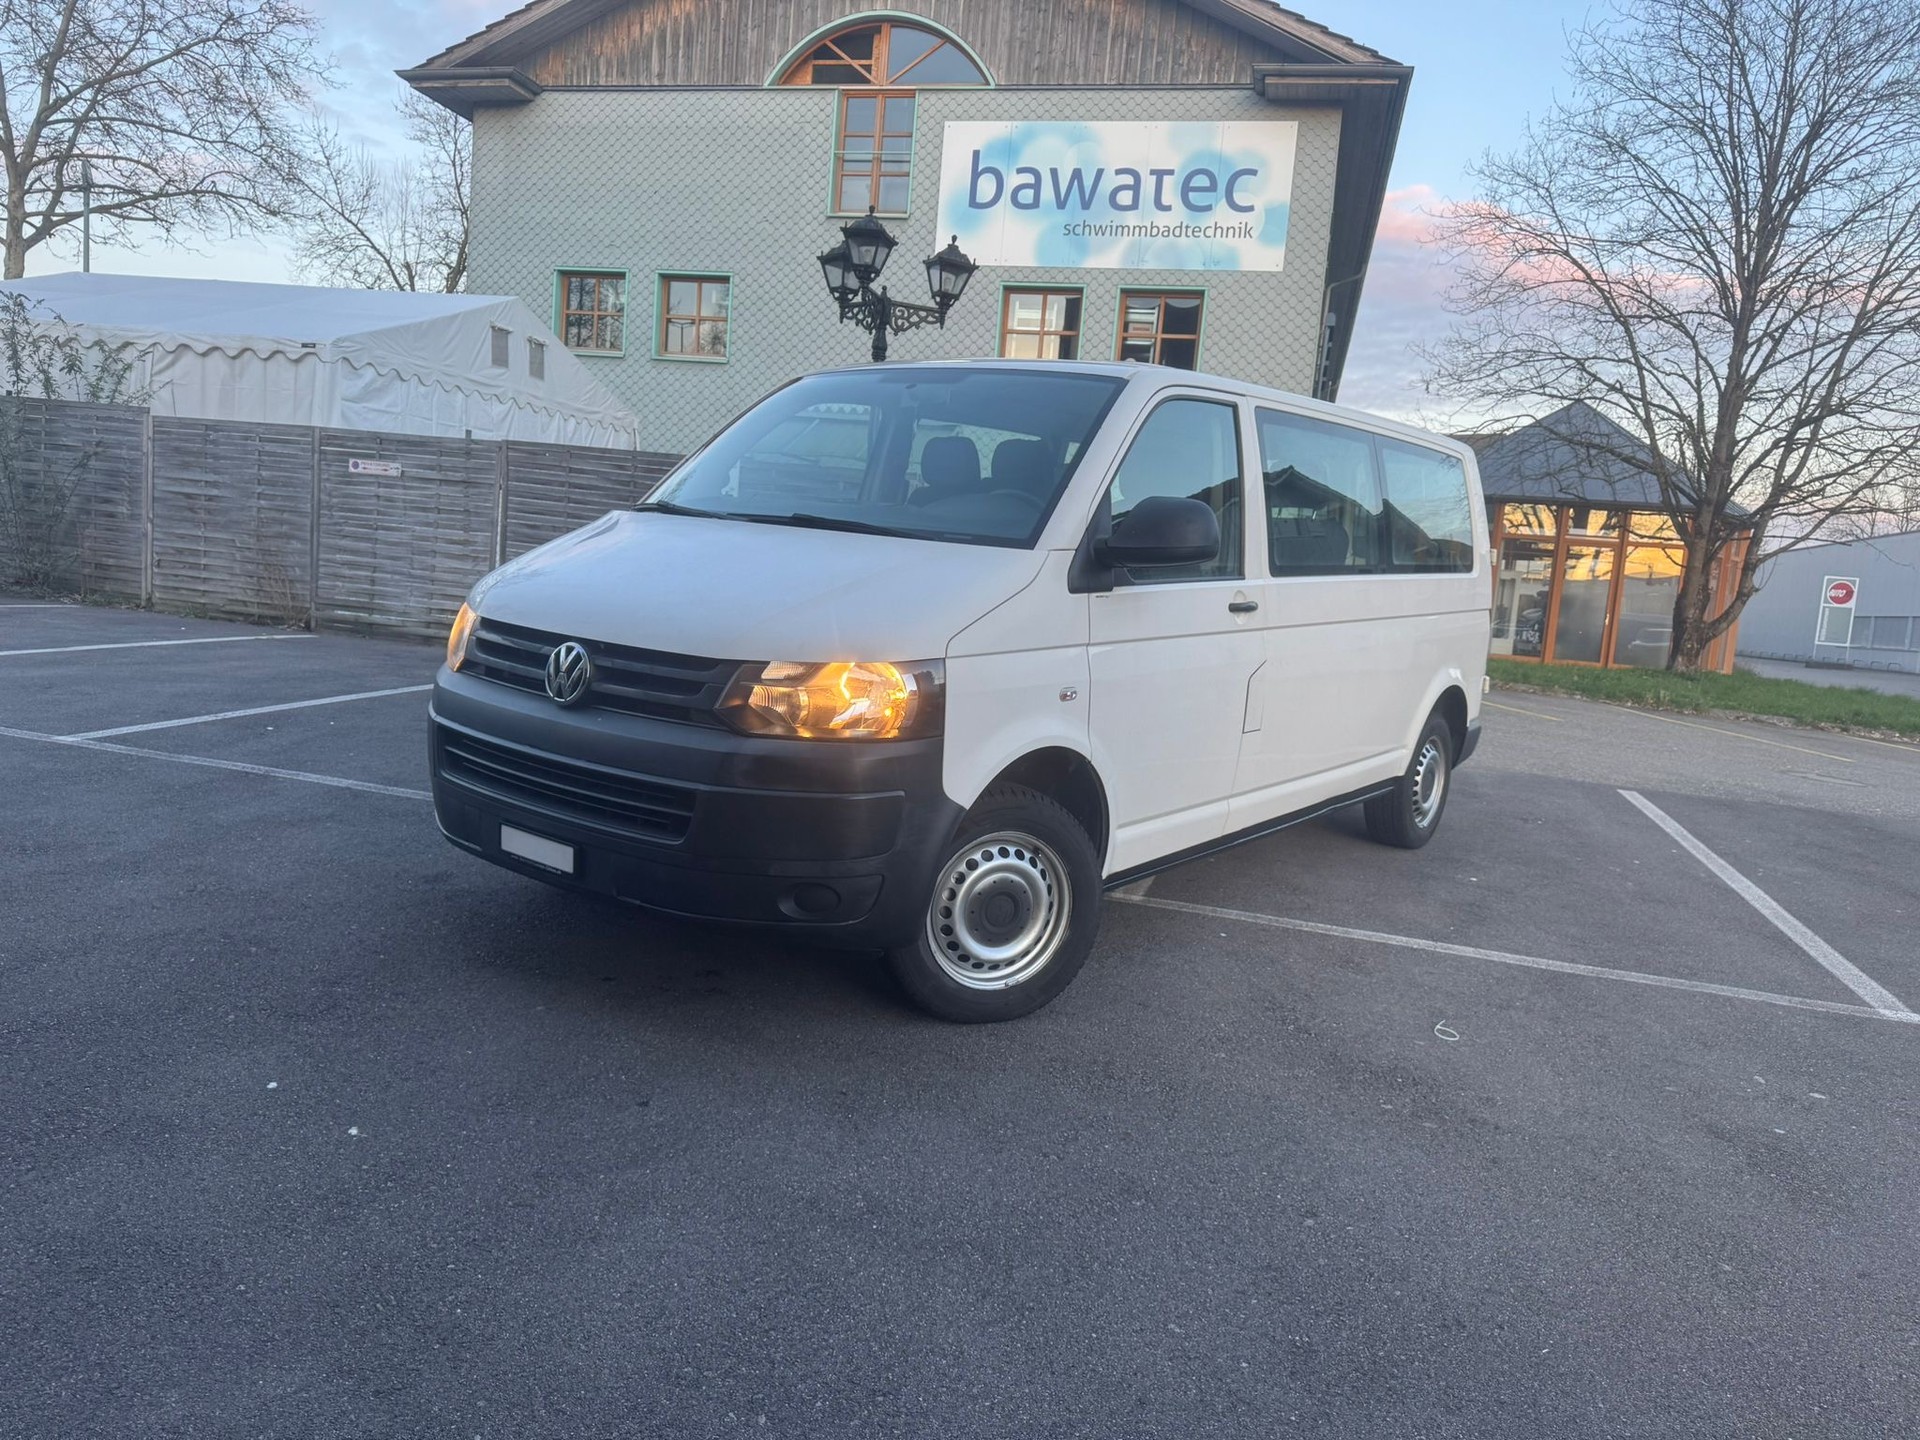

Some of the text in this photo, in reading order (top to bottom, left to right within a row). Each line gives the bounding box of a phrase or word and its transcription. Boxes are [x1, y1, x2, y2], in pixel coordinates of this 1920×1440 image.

[968, 149, 1259, 213] bawatec
[1063, 219, 1254, 240] schwimmbadtechnik
[545, 642, 590, 703] VW
